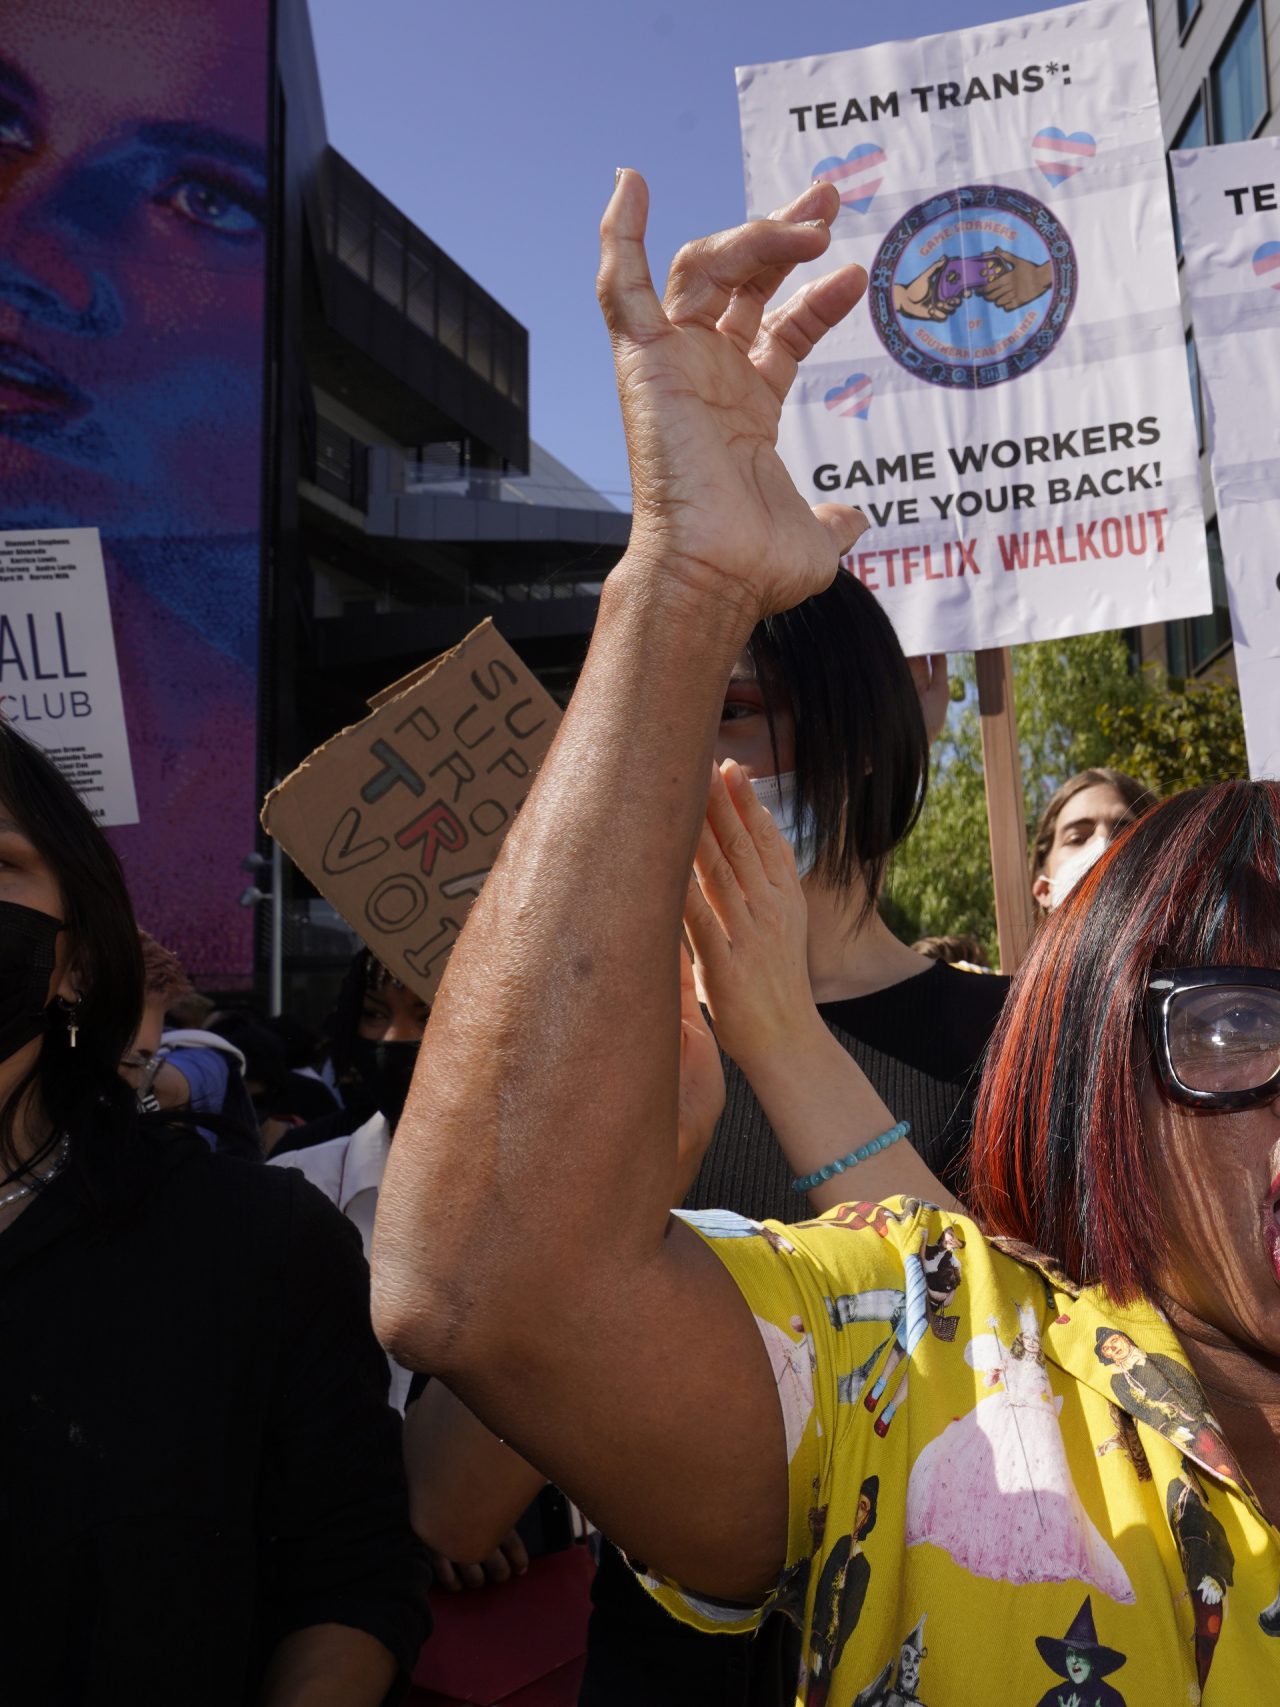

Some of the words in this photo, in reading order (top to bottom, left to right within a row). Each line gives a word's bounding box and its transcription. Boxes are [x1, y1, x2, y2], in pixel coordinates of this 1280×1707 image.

[790, 92, 900, 132] TEAM
[920, 227, 953, 256] GAME
[955, 220, 1018, 241] WORKERS
[916, 327, 970, 359] SOUTHERN
[975, 311, 1037, 358] CALIFORNIA
[968, 319, 981, 329] OF
[813, 452, 936, 493] GAME
[948, 417, 1161, 475] WORKERS
[931, 484, 1036, 520] YOUR
[1048, 461, 1162, 504] BACK!
[998, 508, 1169, 571] WALKOUT
